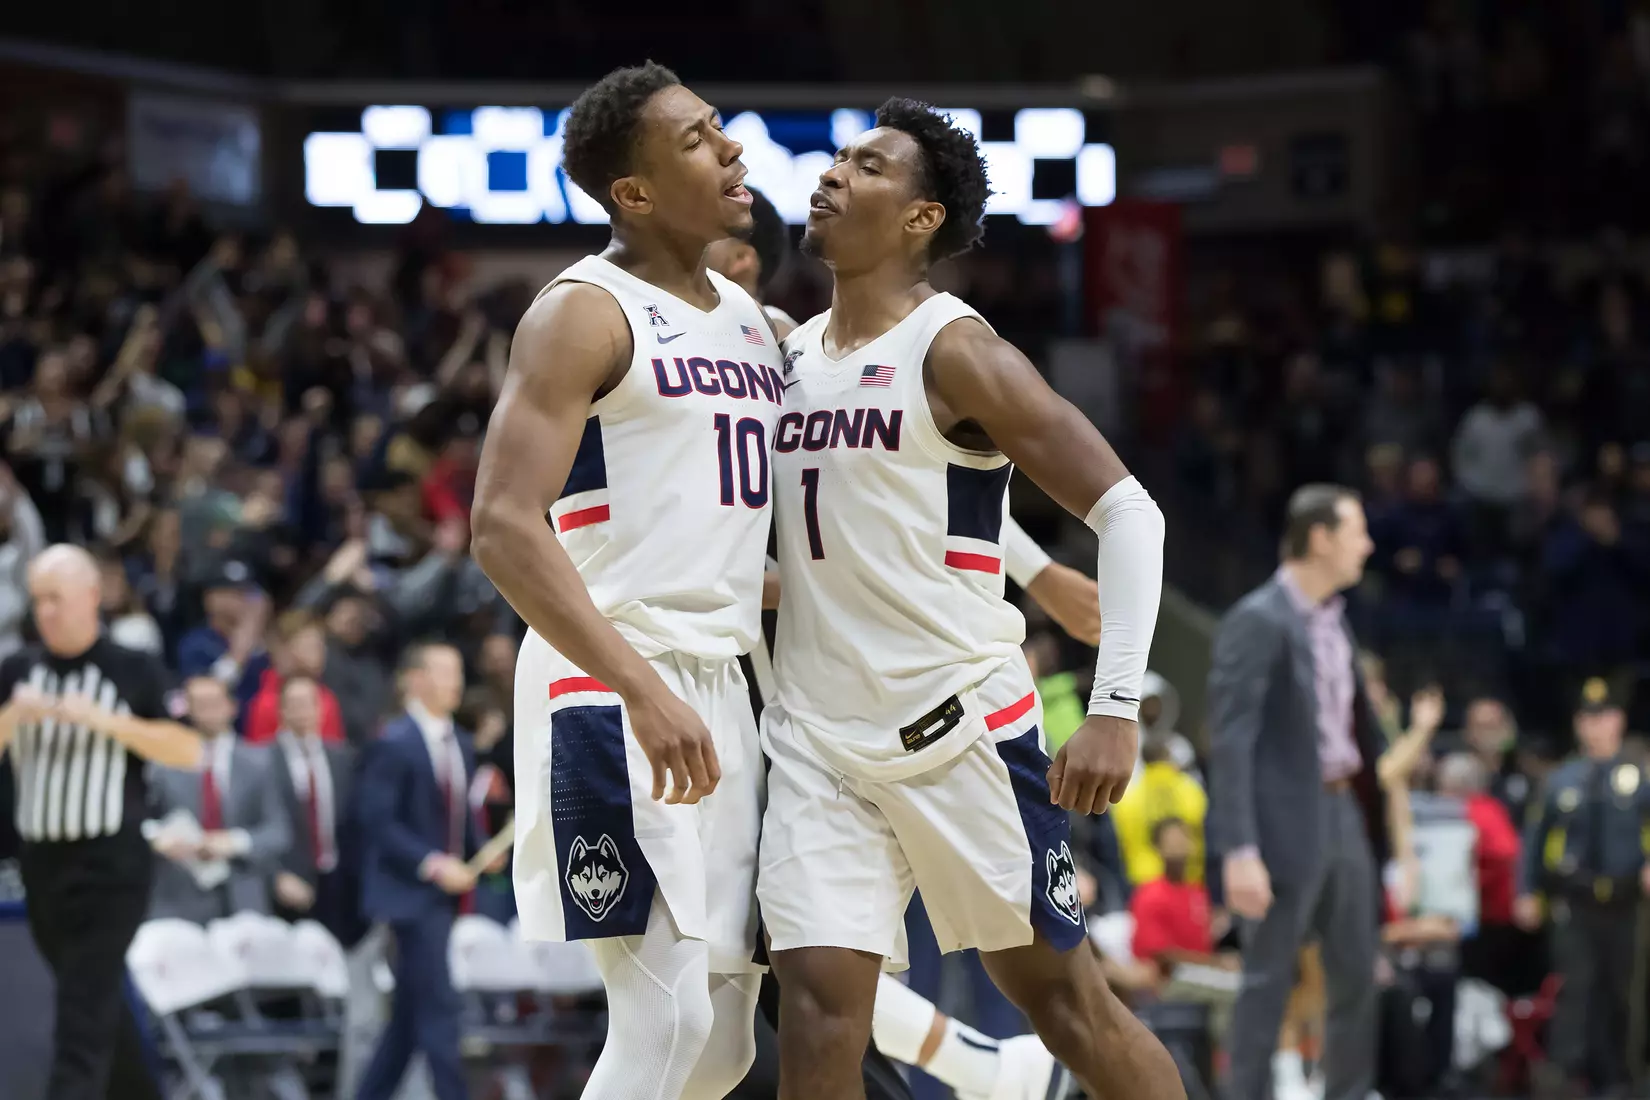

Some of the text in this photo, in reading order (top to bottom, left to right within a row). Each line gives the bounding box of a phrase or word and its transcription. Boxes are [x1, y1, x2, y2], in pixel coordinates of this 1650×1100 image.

[714, 413, 768, 509] 10
[772, 408, 903, 453] CONN
[801, 468, 825, 560] 1
